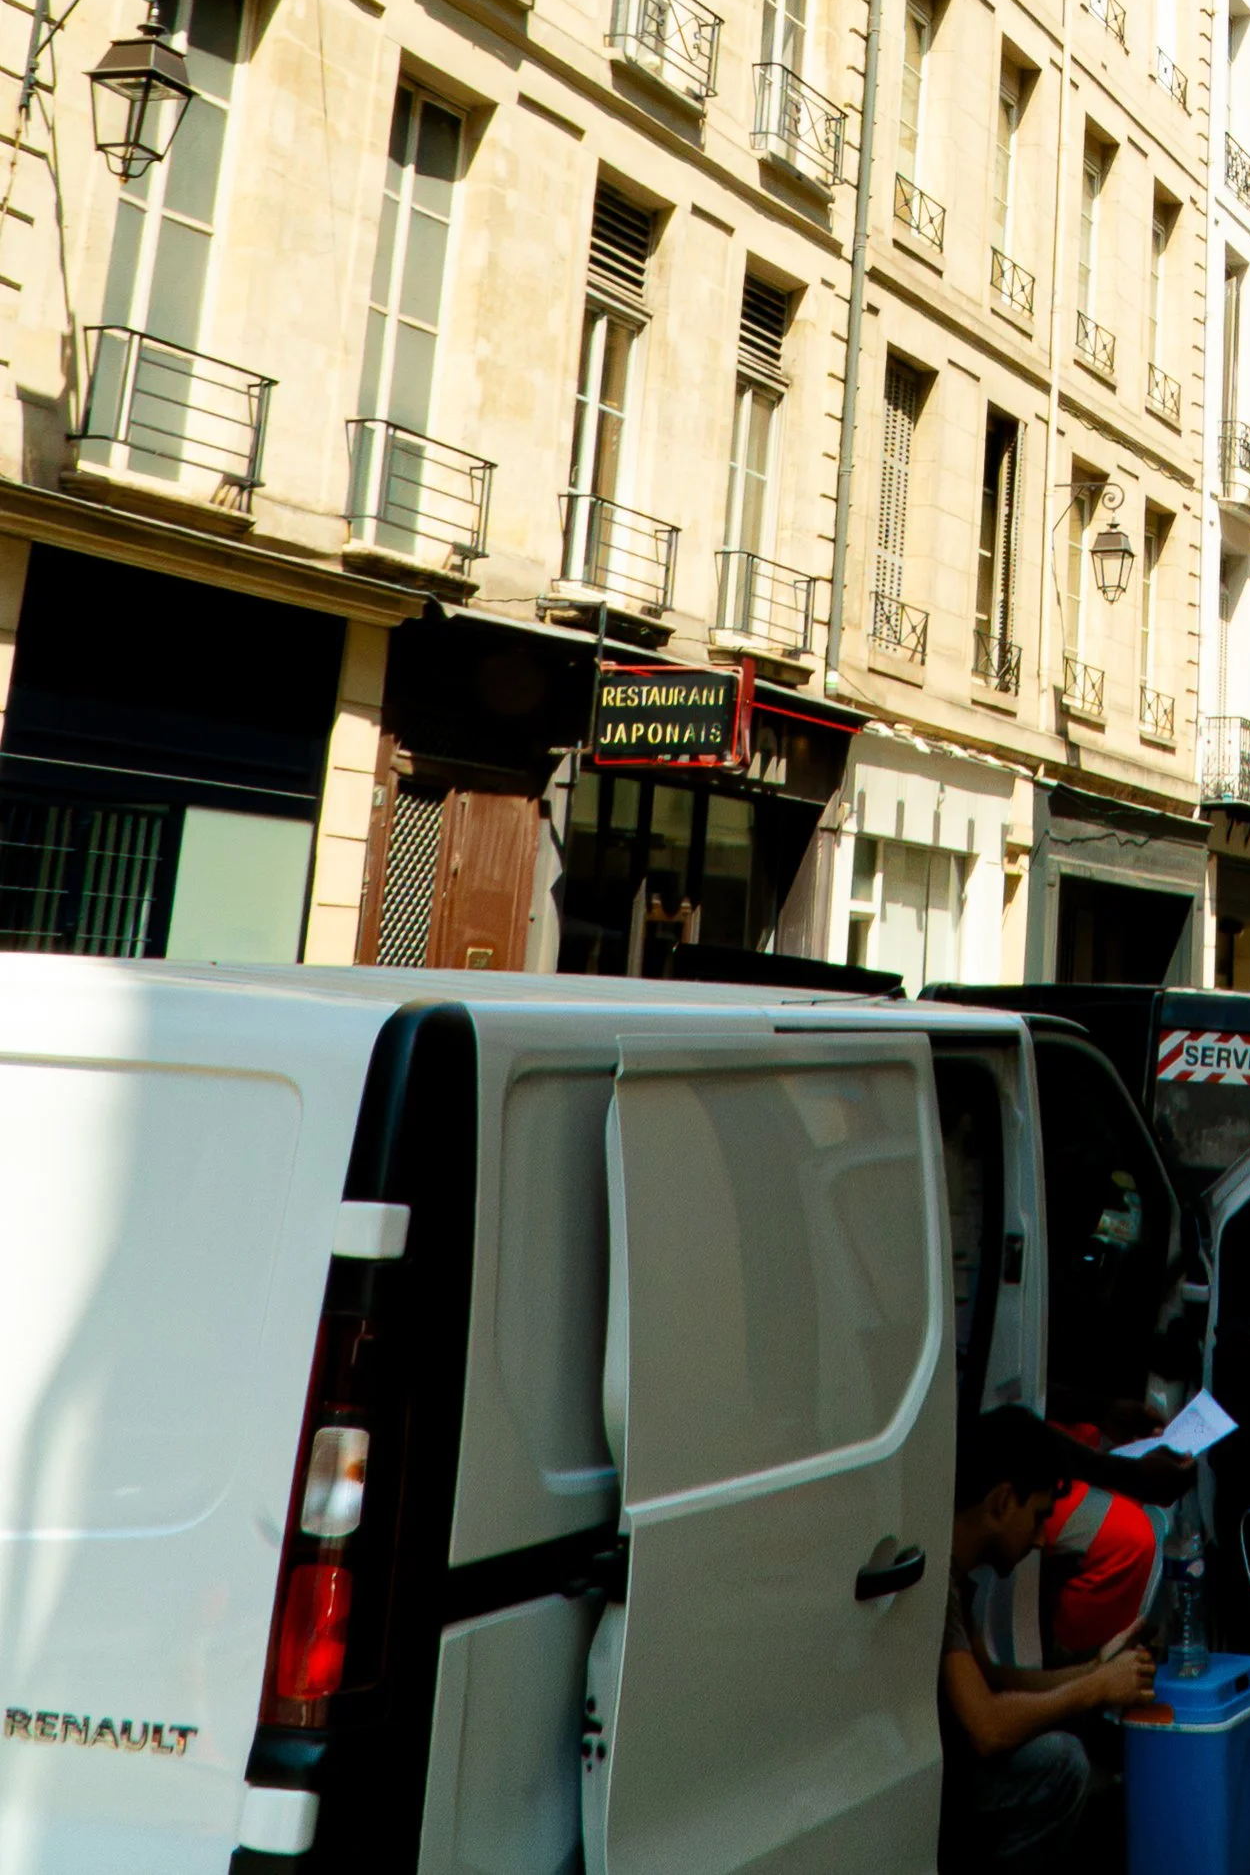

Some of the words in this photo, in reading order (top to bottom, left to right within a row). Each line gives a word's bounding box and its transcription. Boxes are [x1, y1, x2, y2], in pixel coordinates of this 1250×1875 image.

[601, 685, 726, 707] RESTAURANT
[600, 722, 722, 745] JAPONAIS
[3, 1706, 198, 1757] RENAULT
